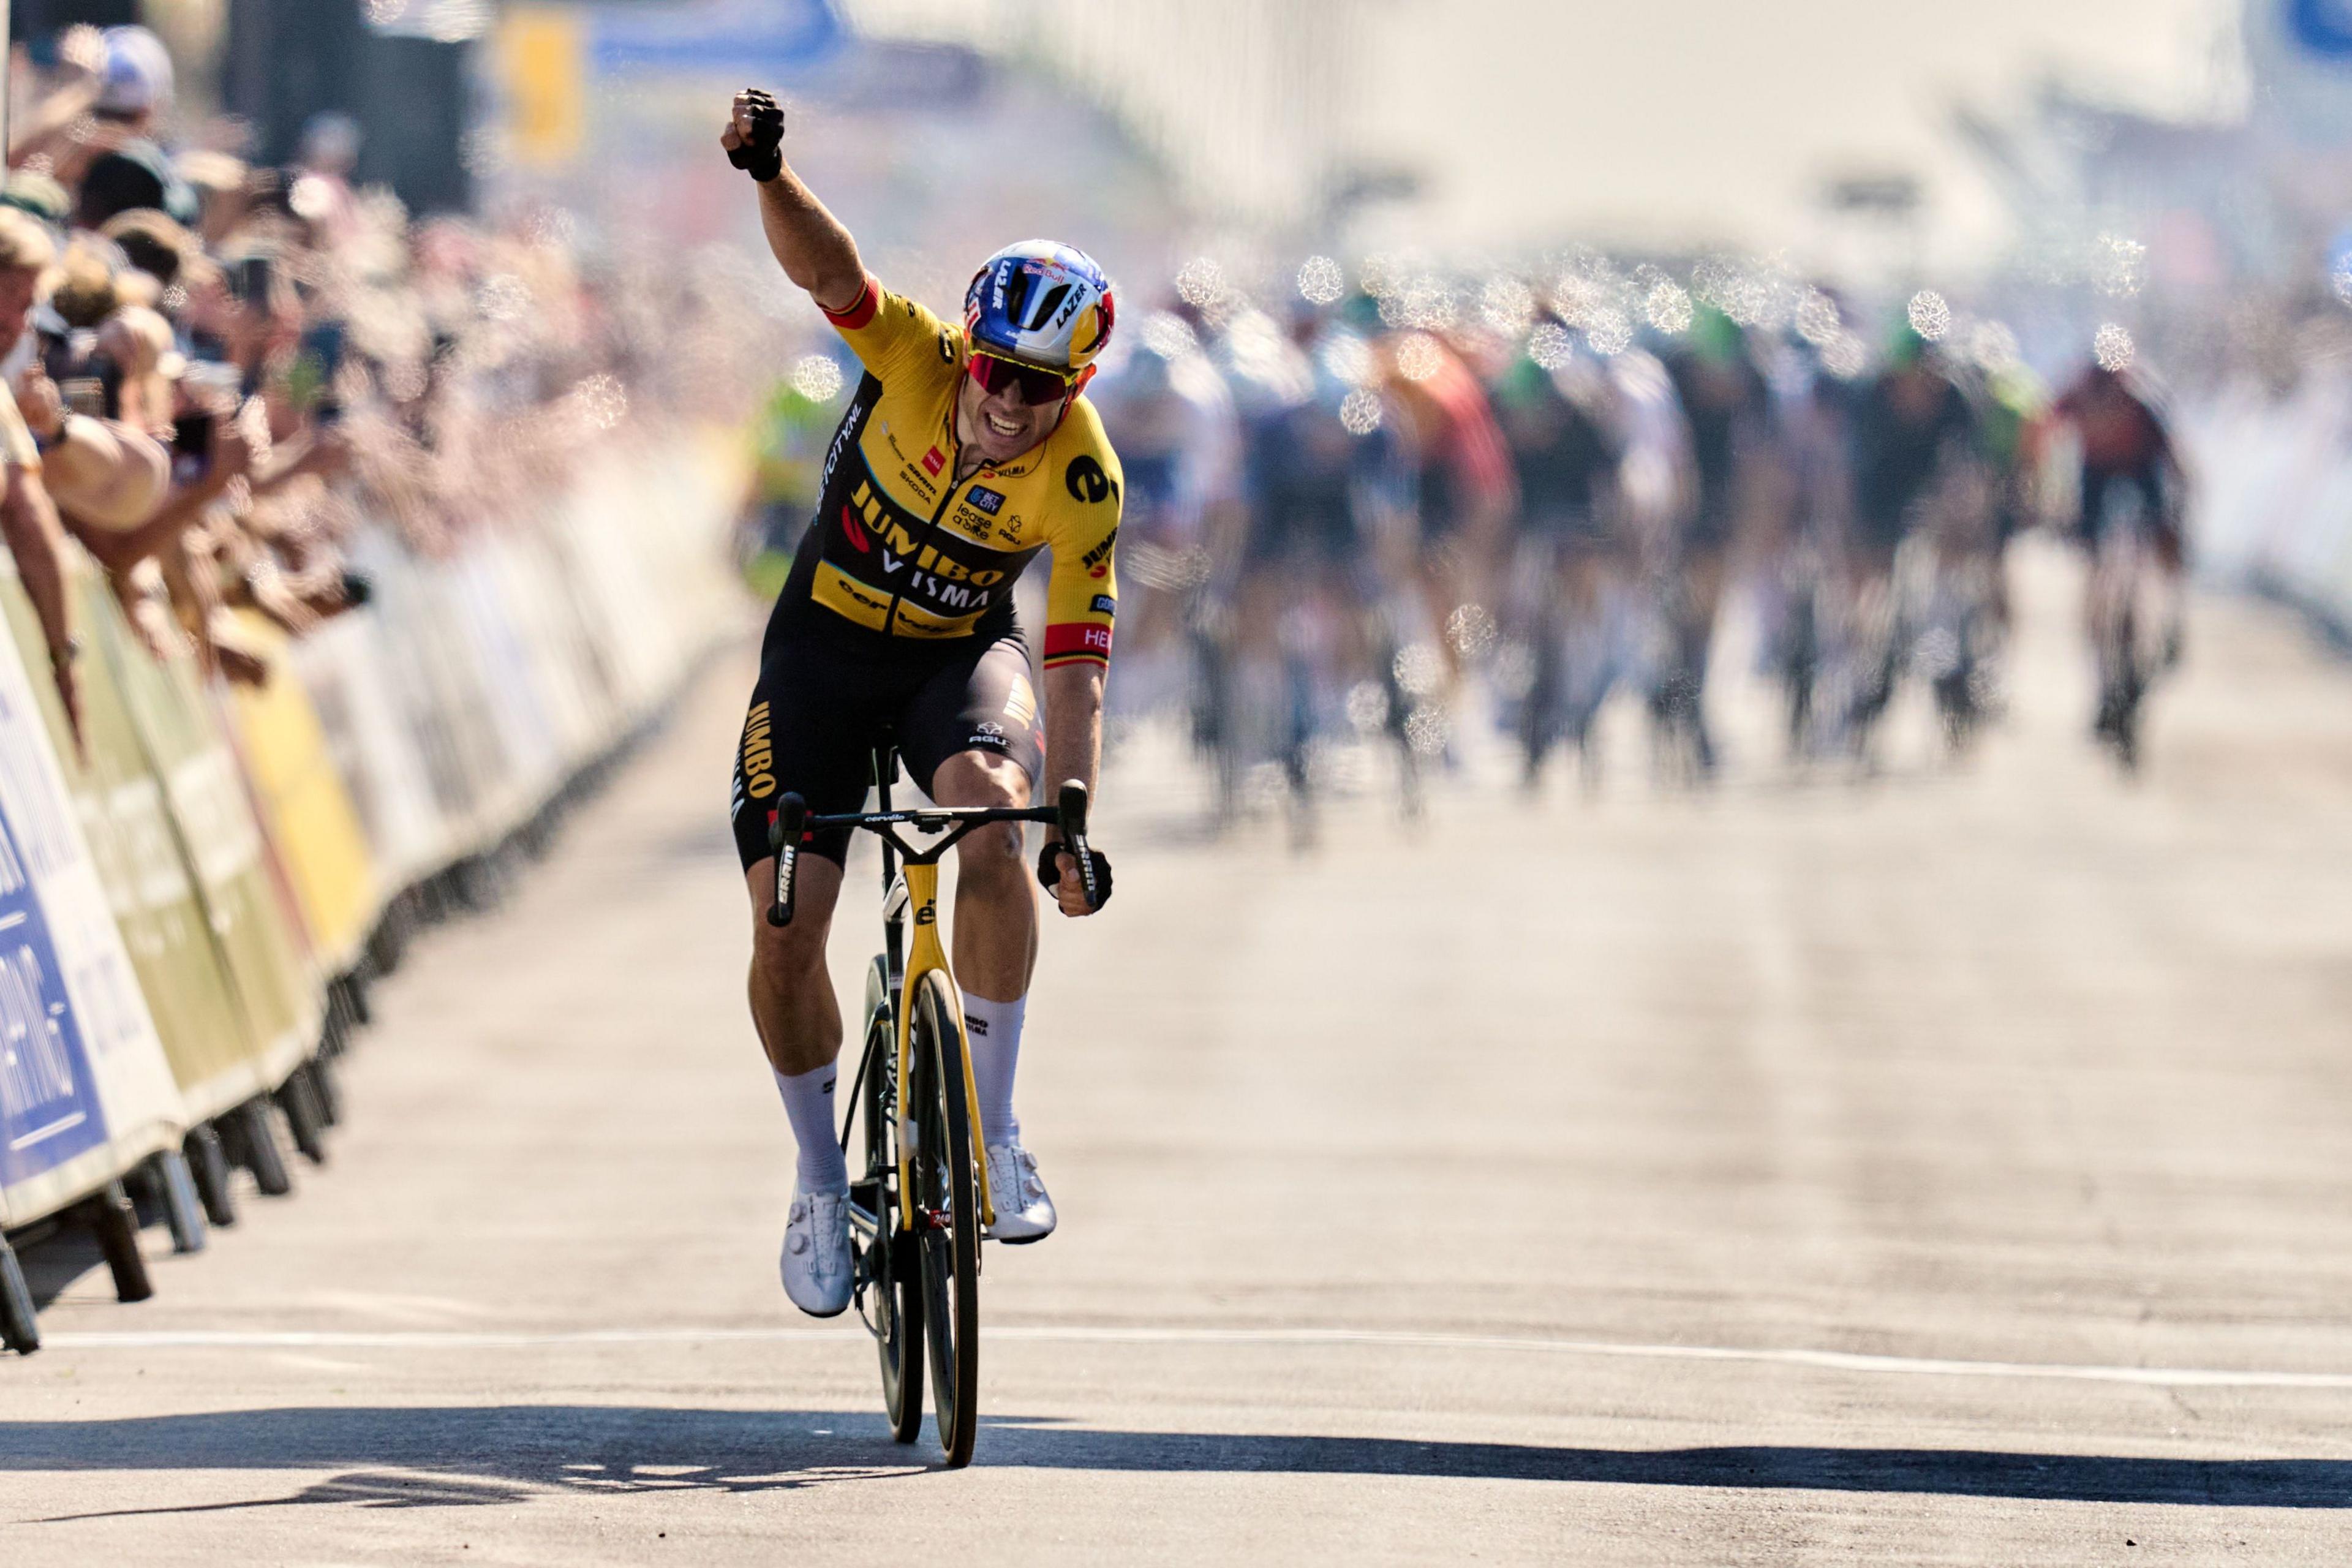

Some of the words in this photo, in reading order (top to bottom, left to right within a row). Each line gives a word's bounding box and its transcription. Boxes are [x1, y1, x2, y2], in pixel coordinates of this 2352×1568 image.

[992, 260, 1011, 309] LAZER
[1022, 263, 1044, 276] Red
[1044, 270, 1065, 285] Bull
[1056, 282, 1087, 330] LAZER
[979, 499, 999, 512] CITY
[984, 491, 1000, 503] BET
[957, 503, 992, 529] lease
[851, 480, 1005, 586] JUMBO
[998, 528, 1022, 546] AGU
[883, 548, 989, 608] VISMA
[745, 701, 777, 799] JUMBO
[968, 735, 1008, 746] AGU
[864, 813, 905, 823] cervélo
[778, 844, 795, 905] SRAM
